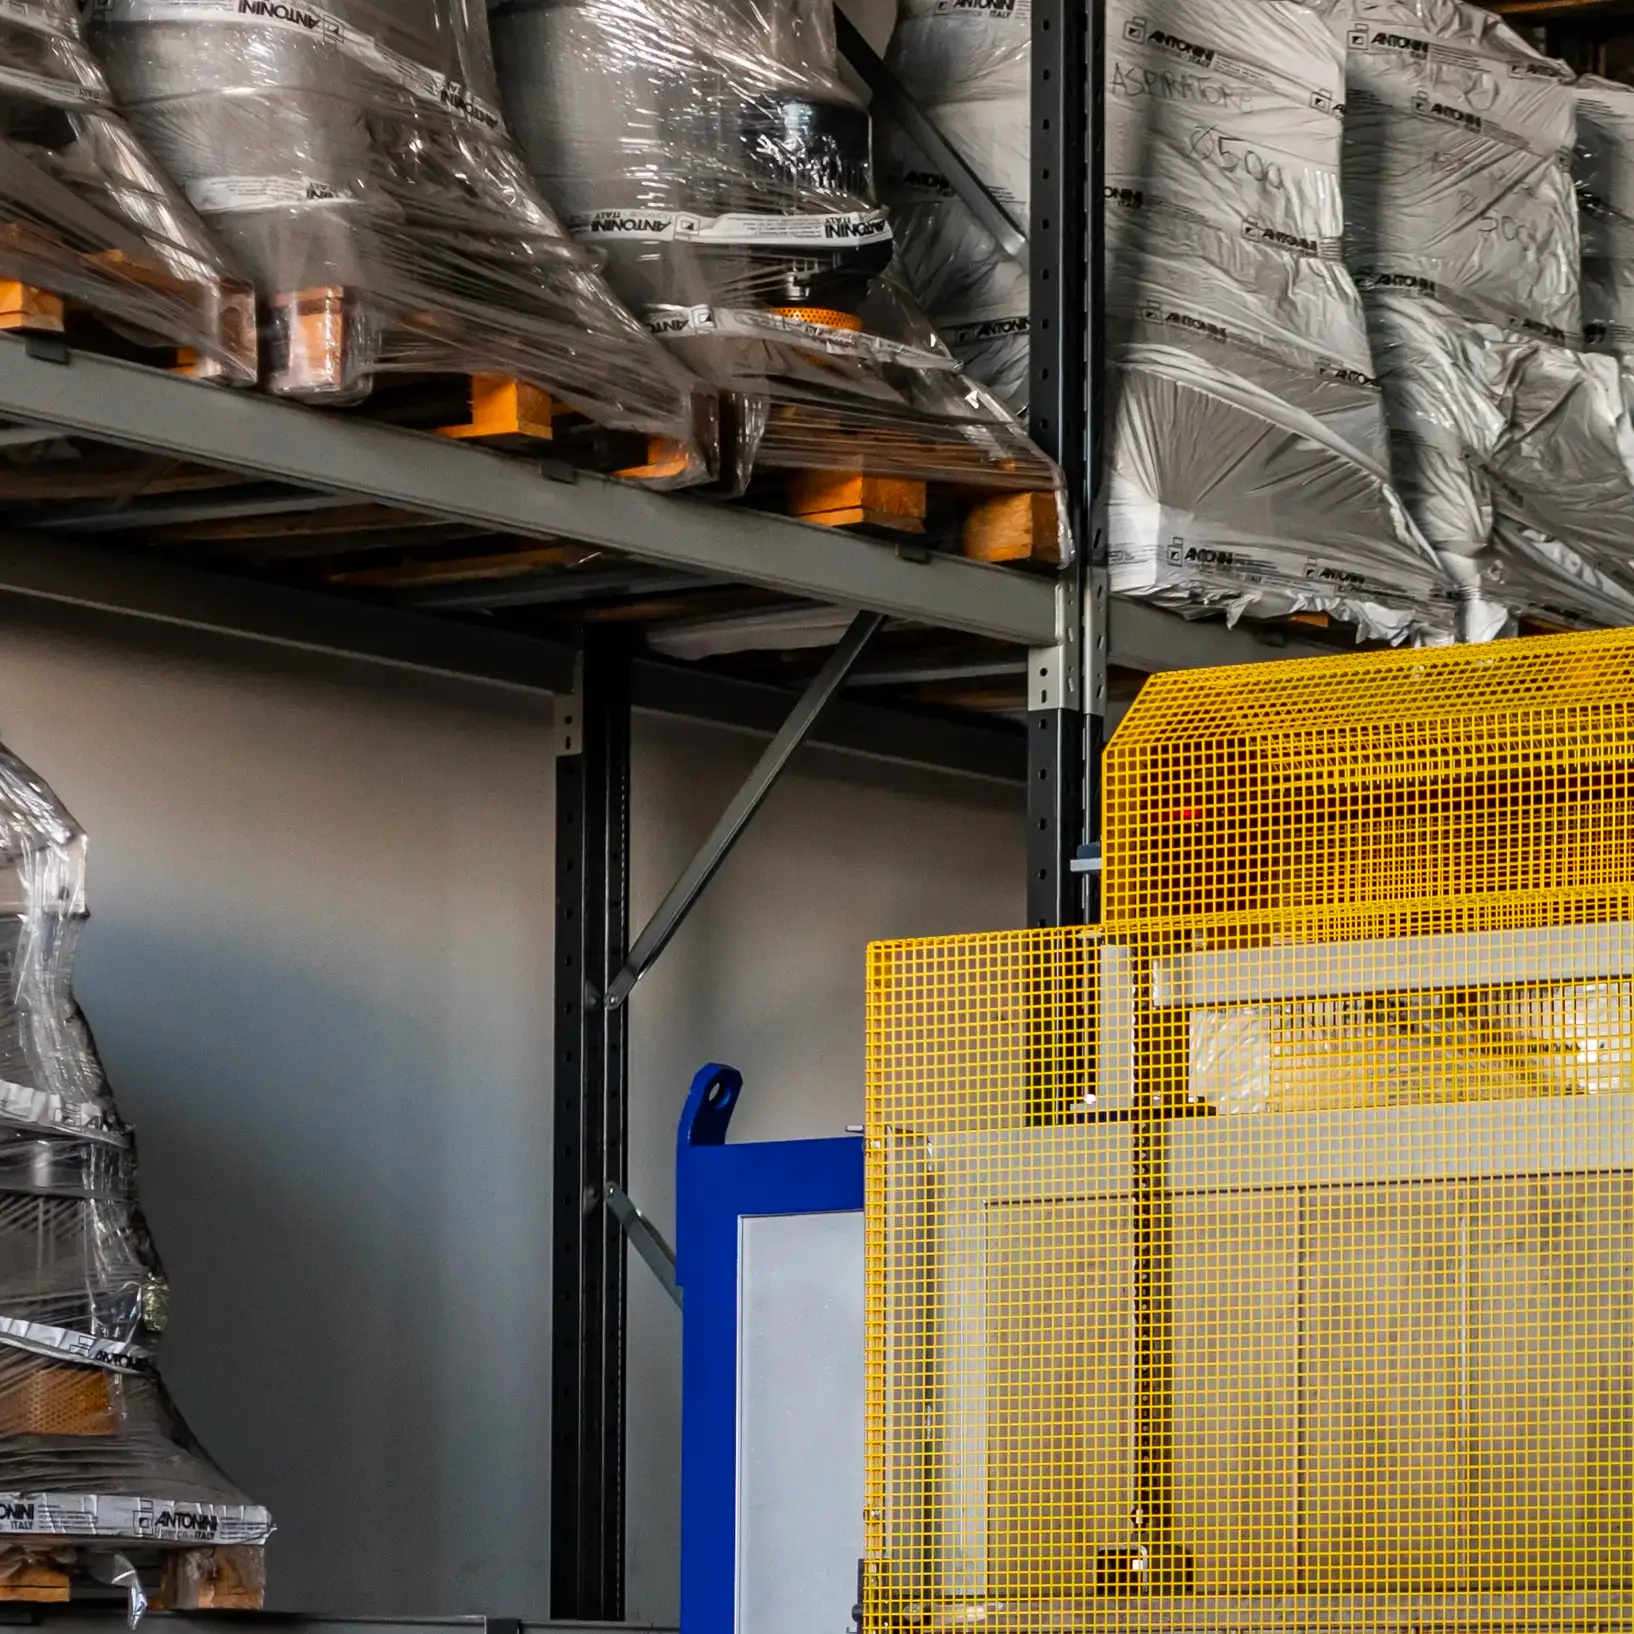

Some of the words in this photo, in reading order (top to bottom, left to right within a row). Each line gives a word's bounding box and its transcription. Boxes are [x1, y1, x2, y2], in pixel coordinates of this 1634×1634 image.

[238, 0, 320, 30] ANTONINI
[591, 218, 673, 233] ANTONINI
[0, 1504, 34, 1519] ONINI
[11, 1520, 34, 1531] ITALY
[155, 1510, 218, 1532] ANTONINI
